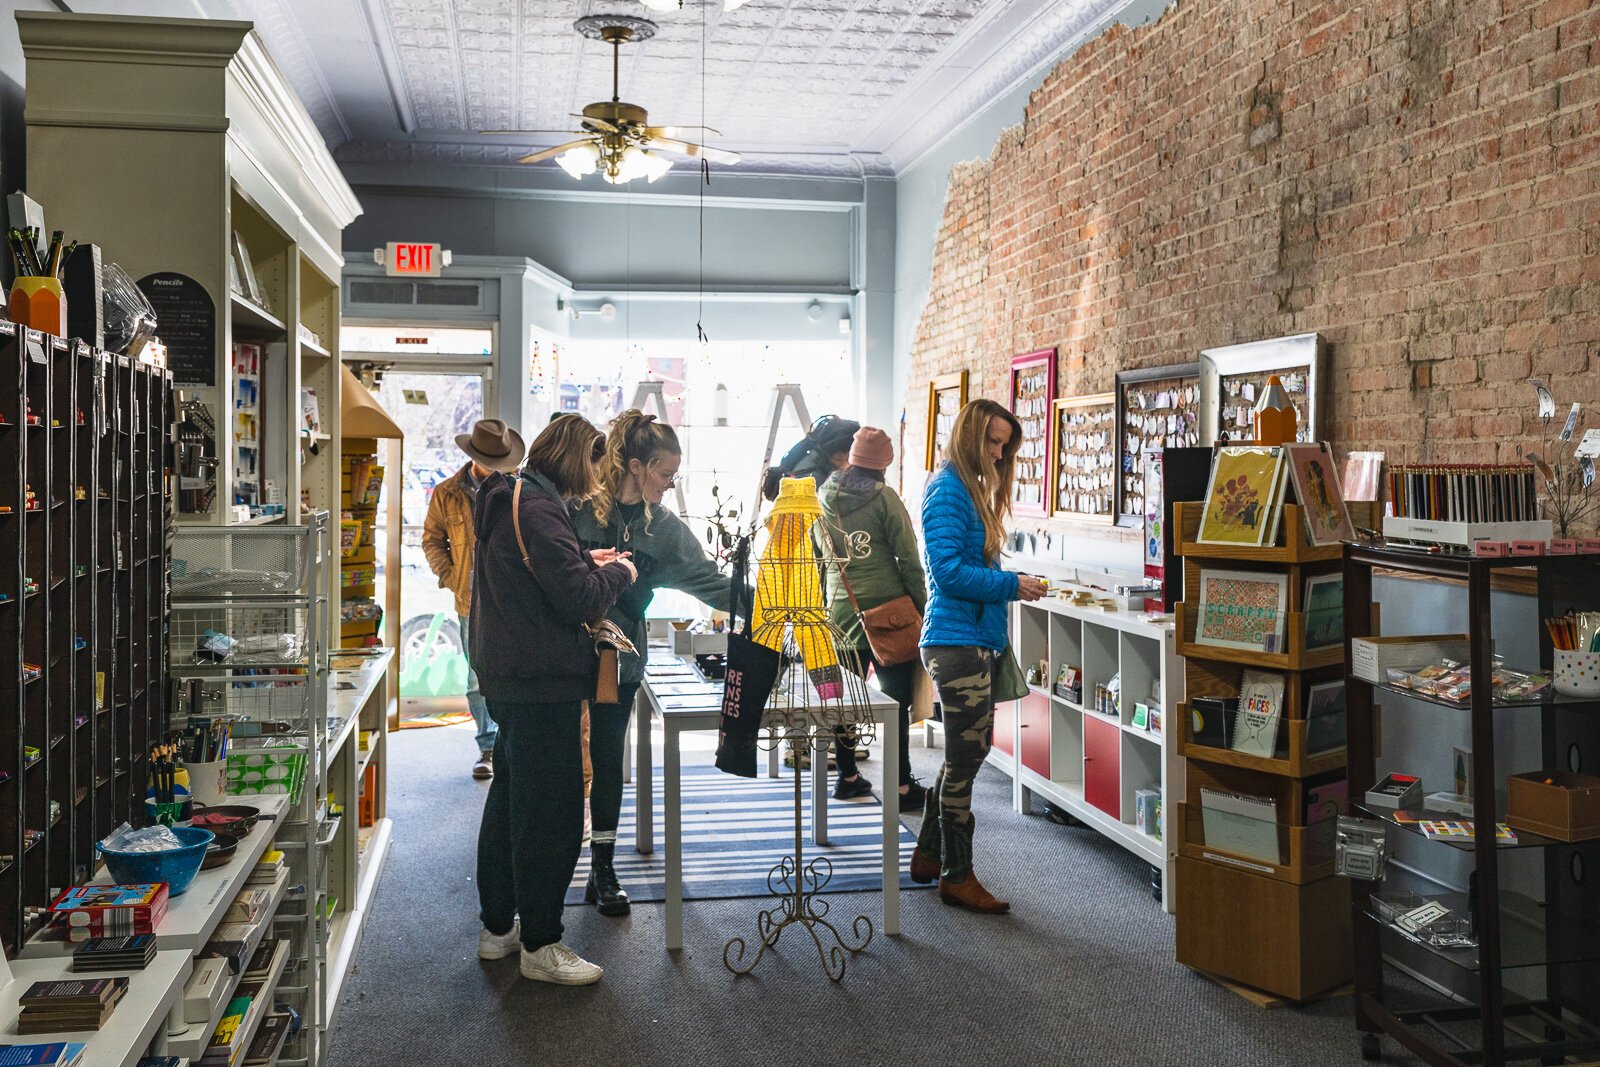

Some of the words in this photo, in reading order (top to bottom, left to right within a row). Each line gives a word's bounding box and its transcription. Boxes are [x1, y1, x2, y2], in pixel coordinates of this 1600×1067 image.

[395, 244, 433, 273] EXIT
[1207, 603, 1276, 619] SCRAPPY
[1248, 698, 1270, 713] FACES
